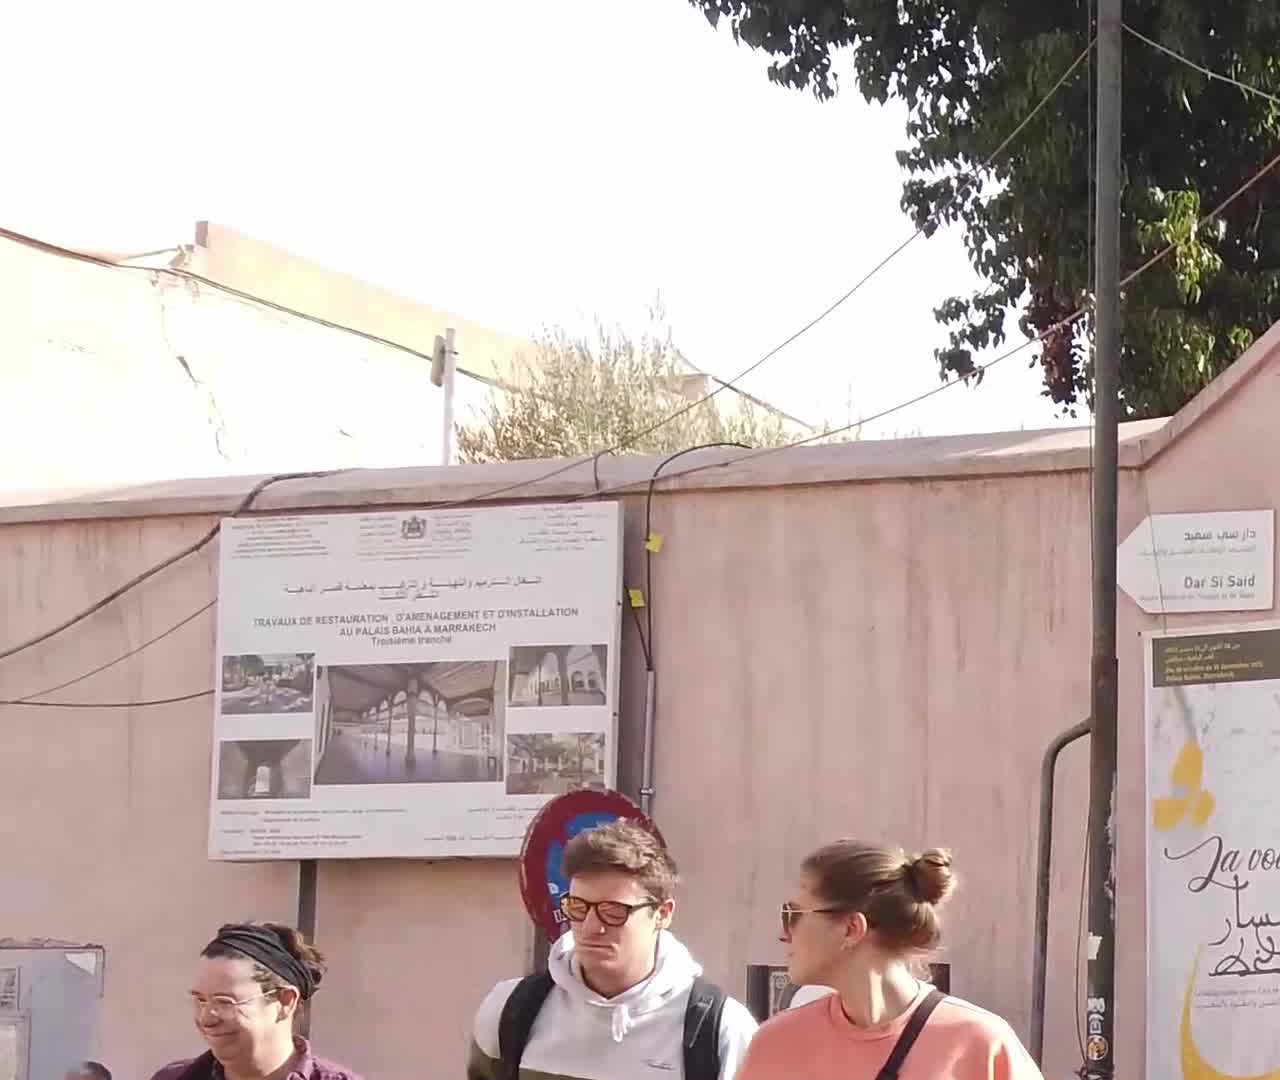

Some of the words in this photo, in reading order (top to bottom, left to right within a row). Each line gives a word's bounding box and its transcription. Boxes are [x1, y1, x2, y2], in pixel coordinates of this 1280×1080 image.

[1183, 531, 1213, 541] سعيد
[1216, 530, 1239, 542] سي
[1241, 527, 1256, 541] دار
[1184, 576, 1206, 589] Dar
[1210, 576, 1223, 588] Si
[253, 616, 297, 627] TRAVAUX
[301, 616, 313, 626] DE
[315, 613, 389, 625] RESTAURATION
[482, 609, 494, 619] ET
[497, 607, 579, 618] D'INSTALLATION
[339, 627, 353, 637] AU
[355, 626, 390, 636] PALAIS
[392, 624, 422, 635] BAHIA
[434, 622, 497, 634] MARRAKECH
[1164, 836, 1249, 892] La
